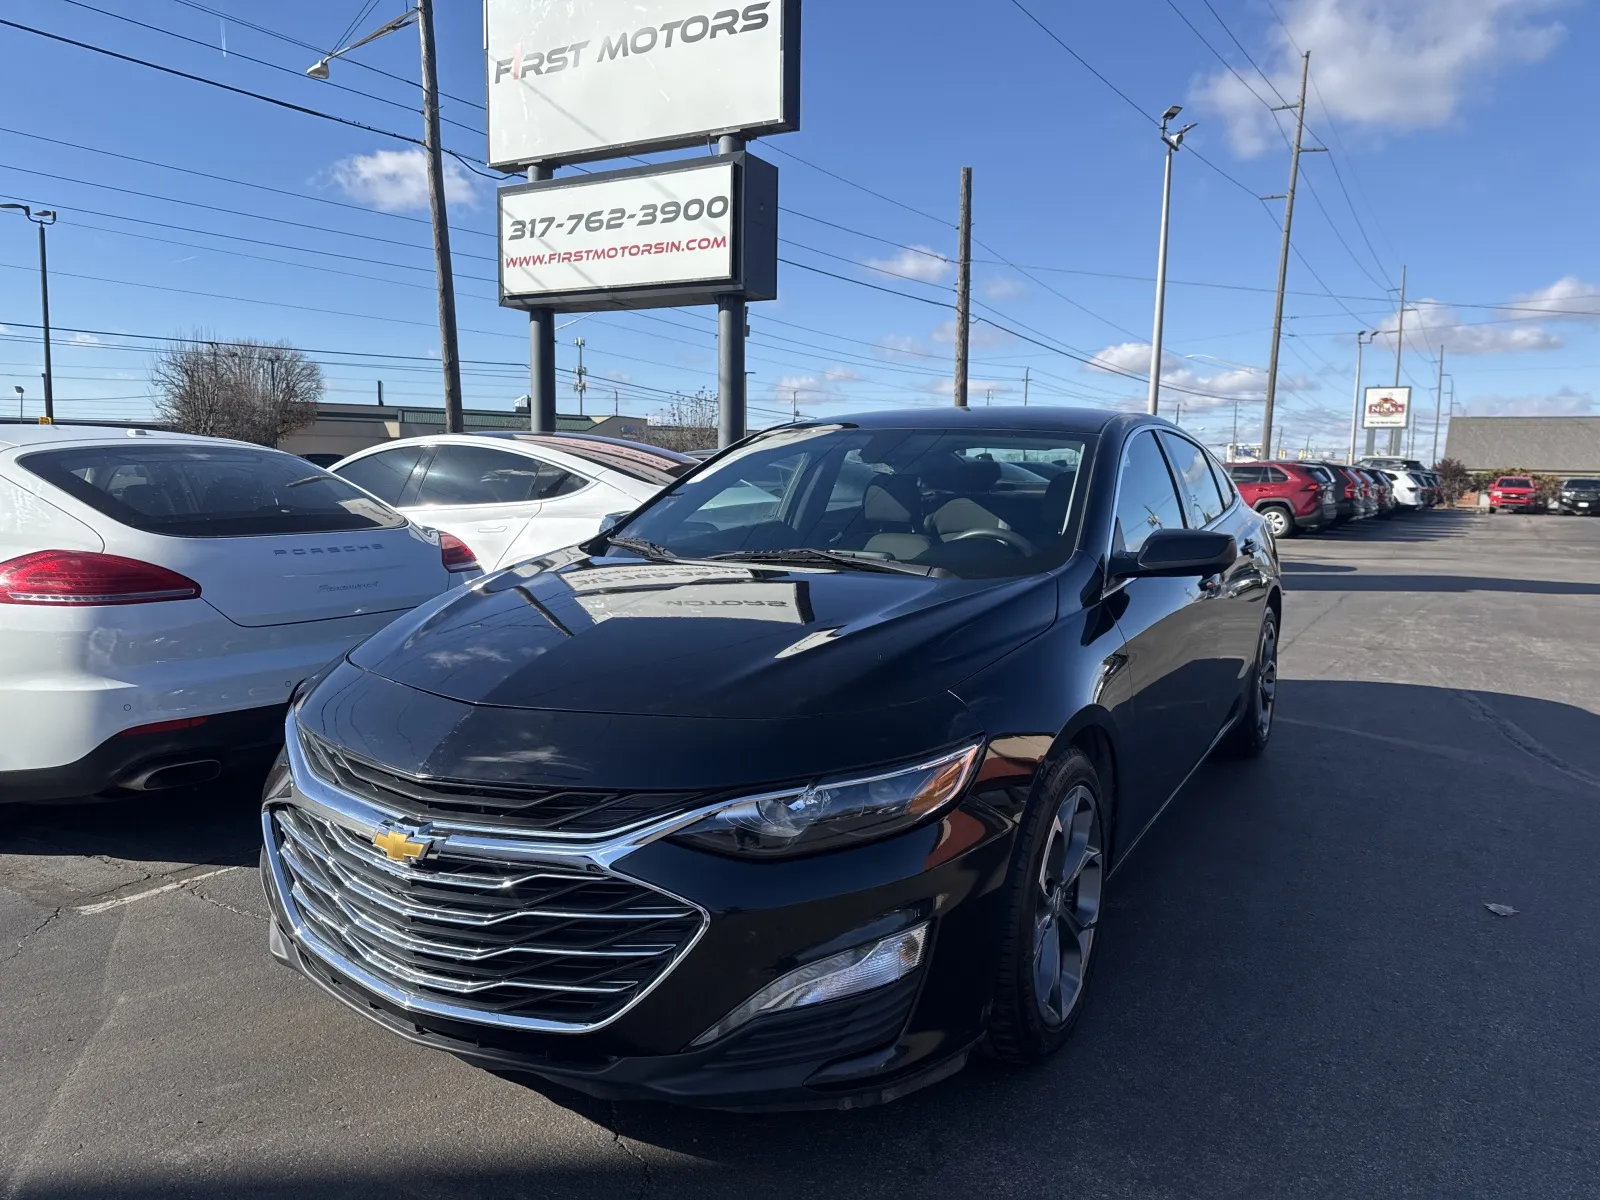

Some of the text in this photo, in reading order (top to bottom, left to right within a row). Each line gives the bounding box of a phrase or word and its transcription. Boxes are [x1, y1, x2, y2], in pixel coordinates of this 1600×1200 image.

[495, 1, 771, 84] FIRST MOTORS
[508, 196, 729, 241] 317-762-3900
[505, 236, 727, 268] WWW.FIRSTMOTORSIN.COM
[273, 543, 385, 556] PORSCHE
